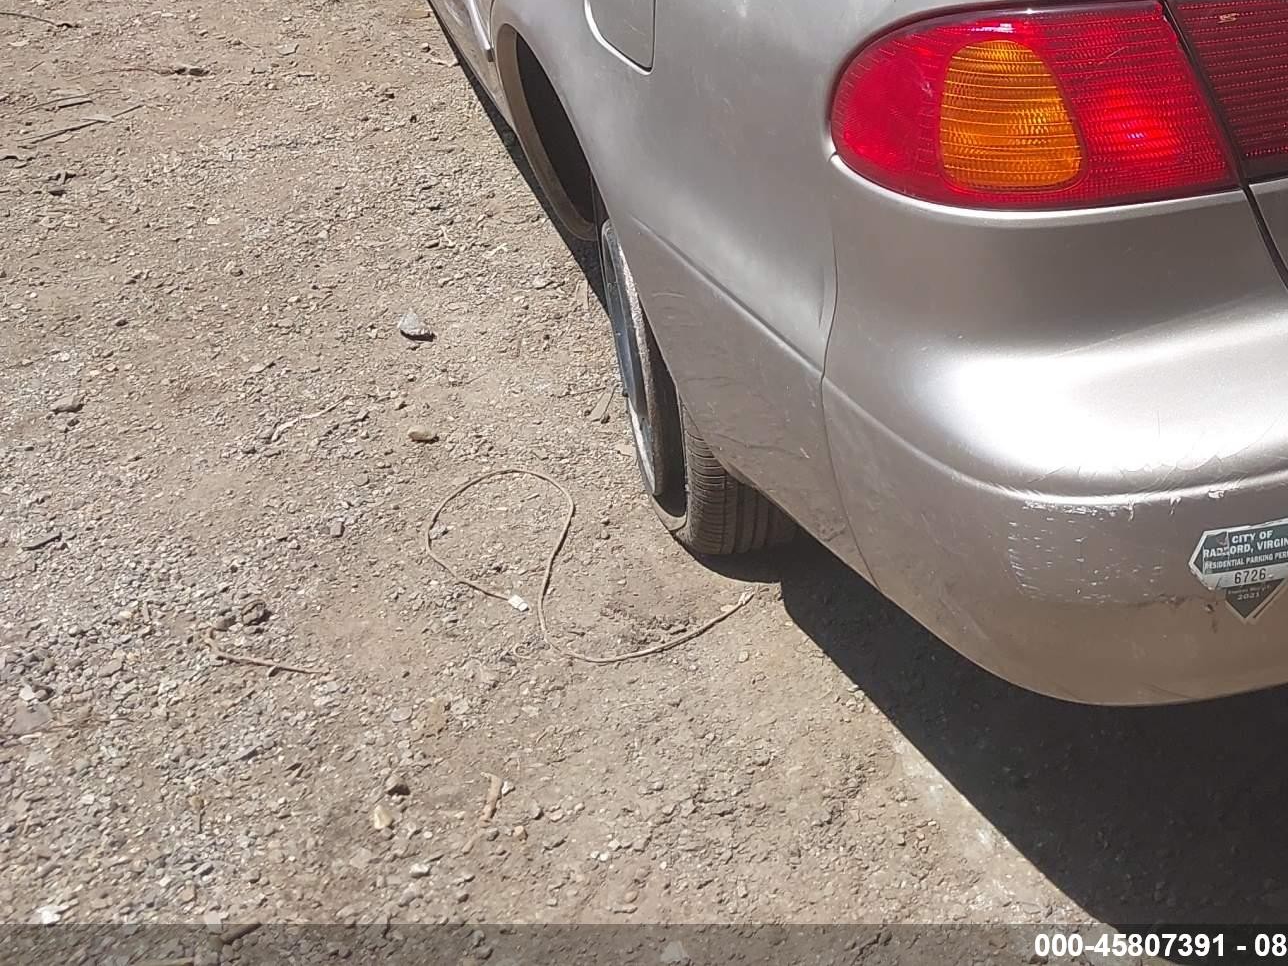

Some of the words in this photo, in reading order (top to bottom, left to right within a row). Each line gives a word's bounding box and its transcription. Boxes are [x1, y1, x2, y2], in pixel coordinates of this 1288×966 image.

[1232, 533, 1256, 544] CITY
[1259, 530, 1273, 540] OF
[1204, 557, 1244, 570] RESIDENTIAL
[1246, 553, 1273, 565] PARKING
[1234, 568, 1266, 584] 6726
